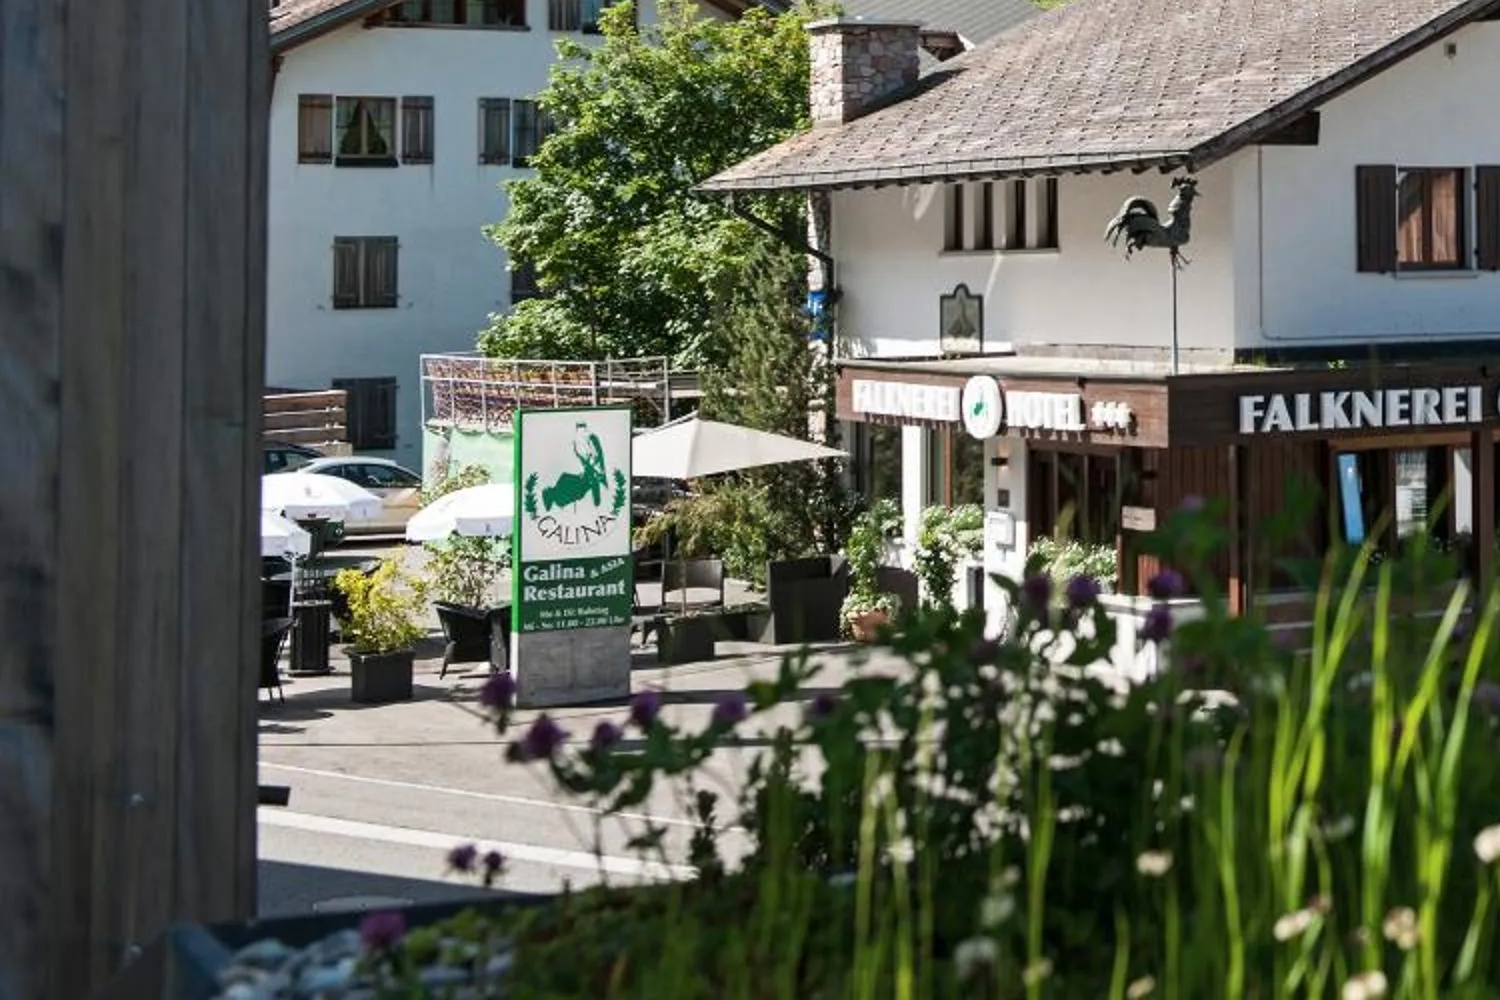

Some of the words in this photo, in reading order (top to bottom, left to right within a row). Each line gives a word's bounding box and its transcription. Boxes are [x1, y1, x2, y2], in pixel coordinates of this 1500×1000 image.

[1005, 392, 1086, 432] HOTEL
[1239, 386, 1482, 434] FALKNEREI
[537, 514, 617, 545] GALINA
[523, 563, 585, 582] Galina
[523, 579, 626, 602] Restaurant
